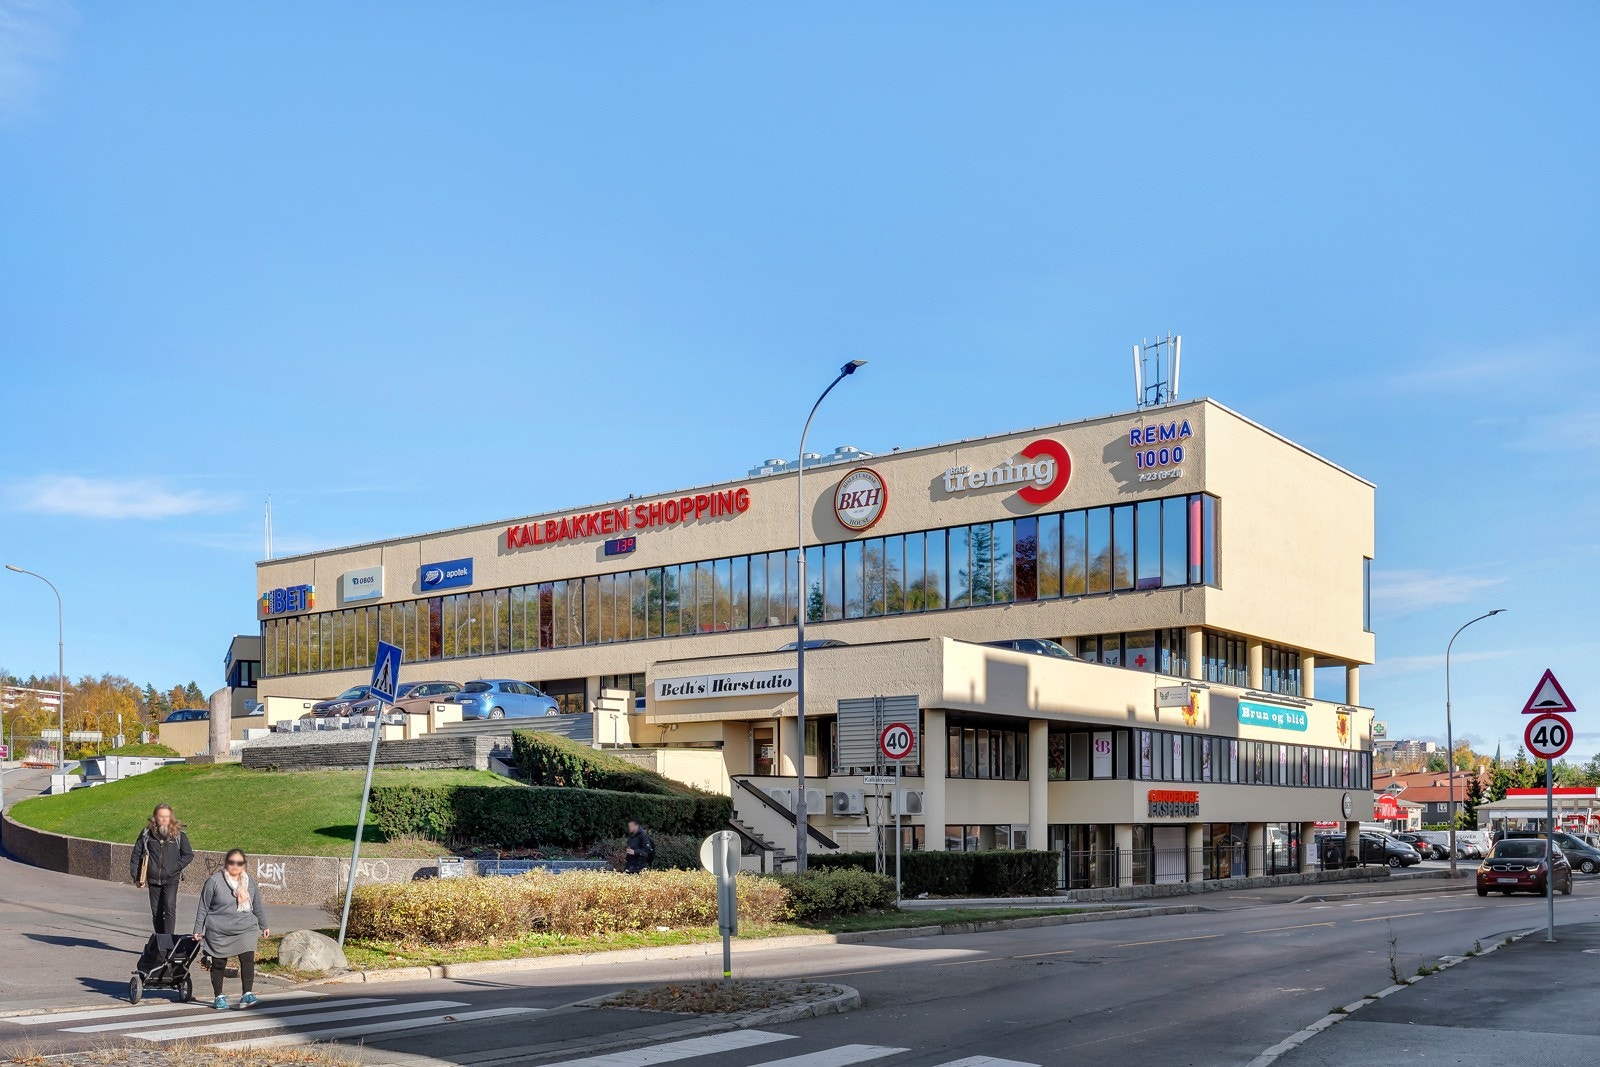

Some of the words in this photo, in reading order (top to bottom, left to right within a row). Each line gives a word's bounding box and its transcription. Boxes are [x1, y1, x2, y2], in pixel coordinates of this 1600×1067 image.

[1129, 420, 1194, 447] REMA
[1136, 445, 1184, 470] 1000
[943, 458, 1055, 493] trening
[837, 487, 882, 511] BKH
[507, 507, 630, 550] KALBAKKEN
[634, 487, 750, 529] SHOPPING
[446, 567, 468, 579] apotek
[274, 584, 309, 614] BET
[711, 674, 792, 693] Hårstudio
[1241, 707, 1269, 720] Brun
[1271, 713, 1284, 724] og
[1286, 713, 1305, 726] blid
[886, 731, 909, 750] 40
[1533, 724, 1566, 747] 40
